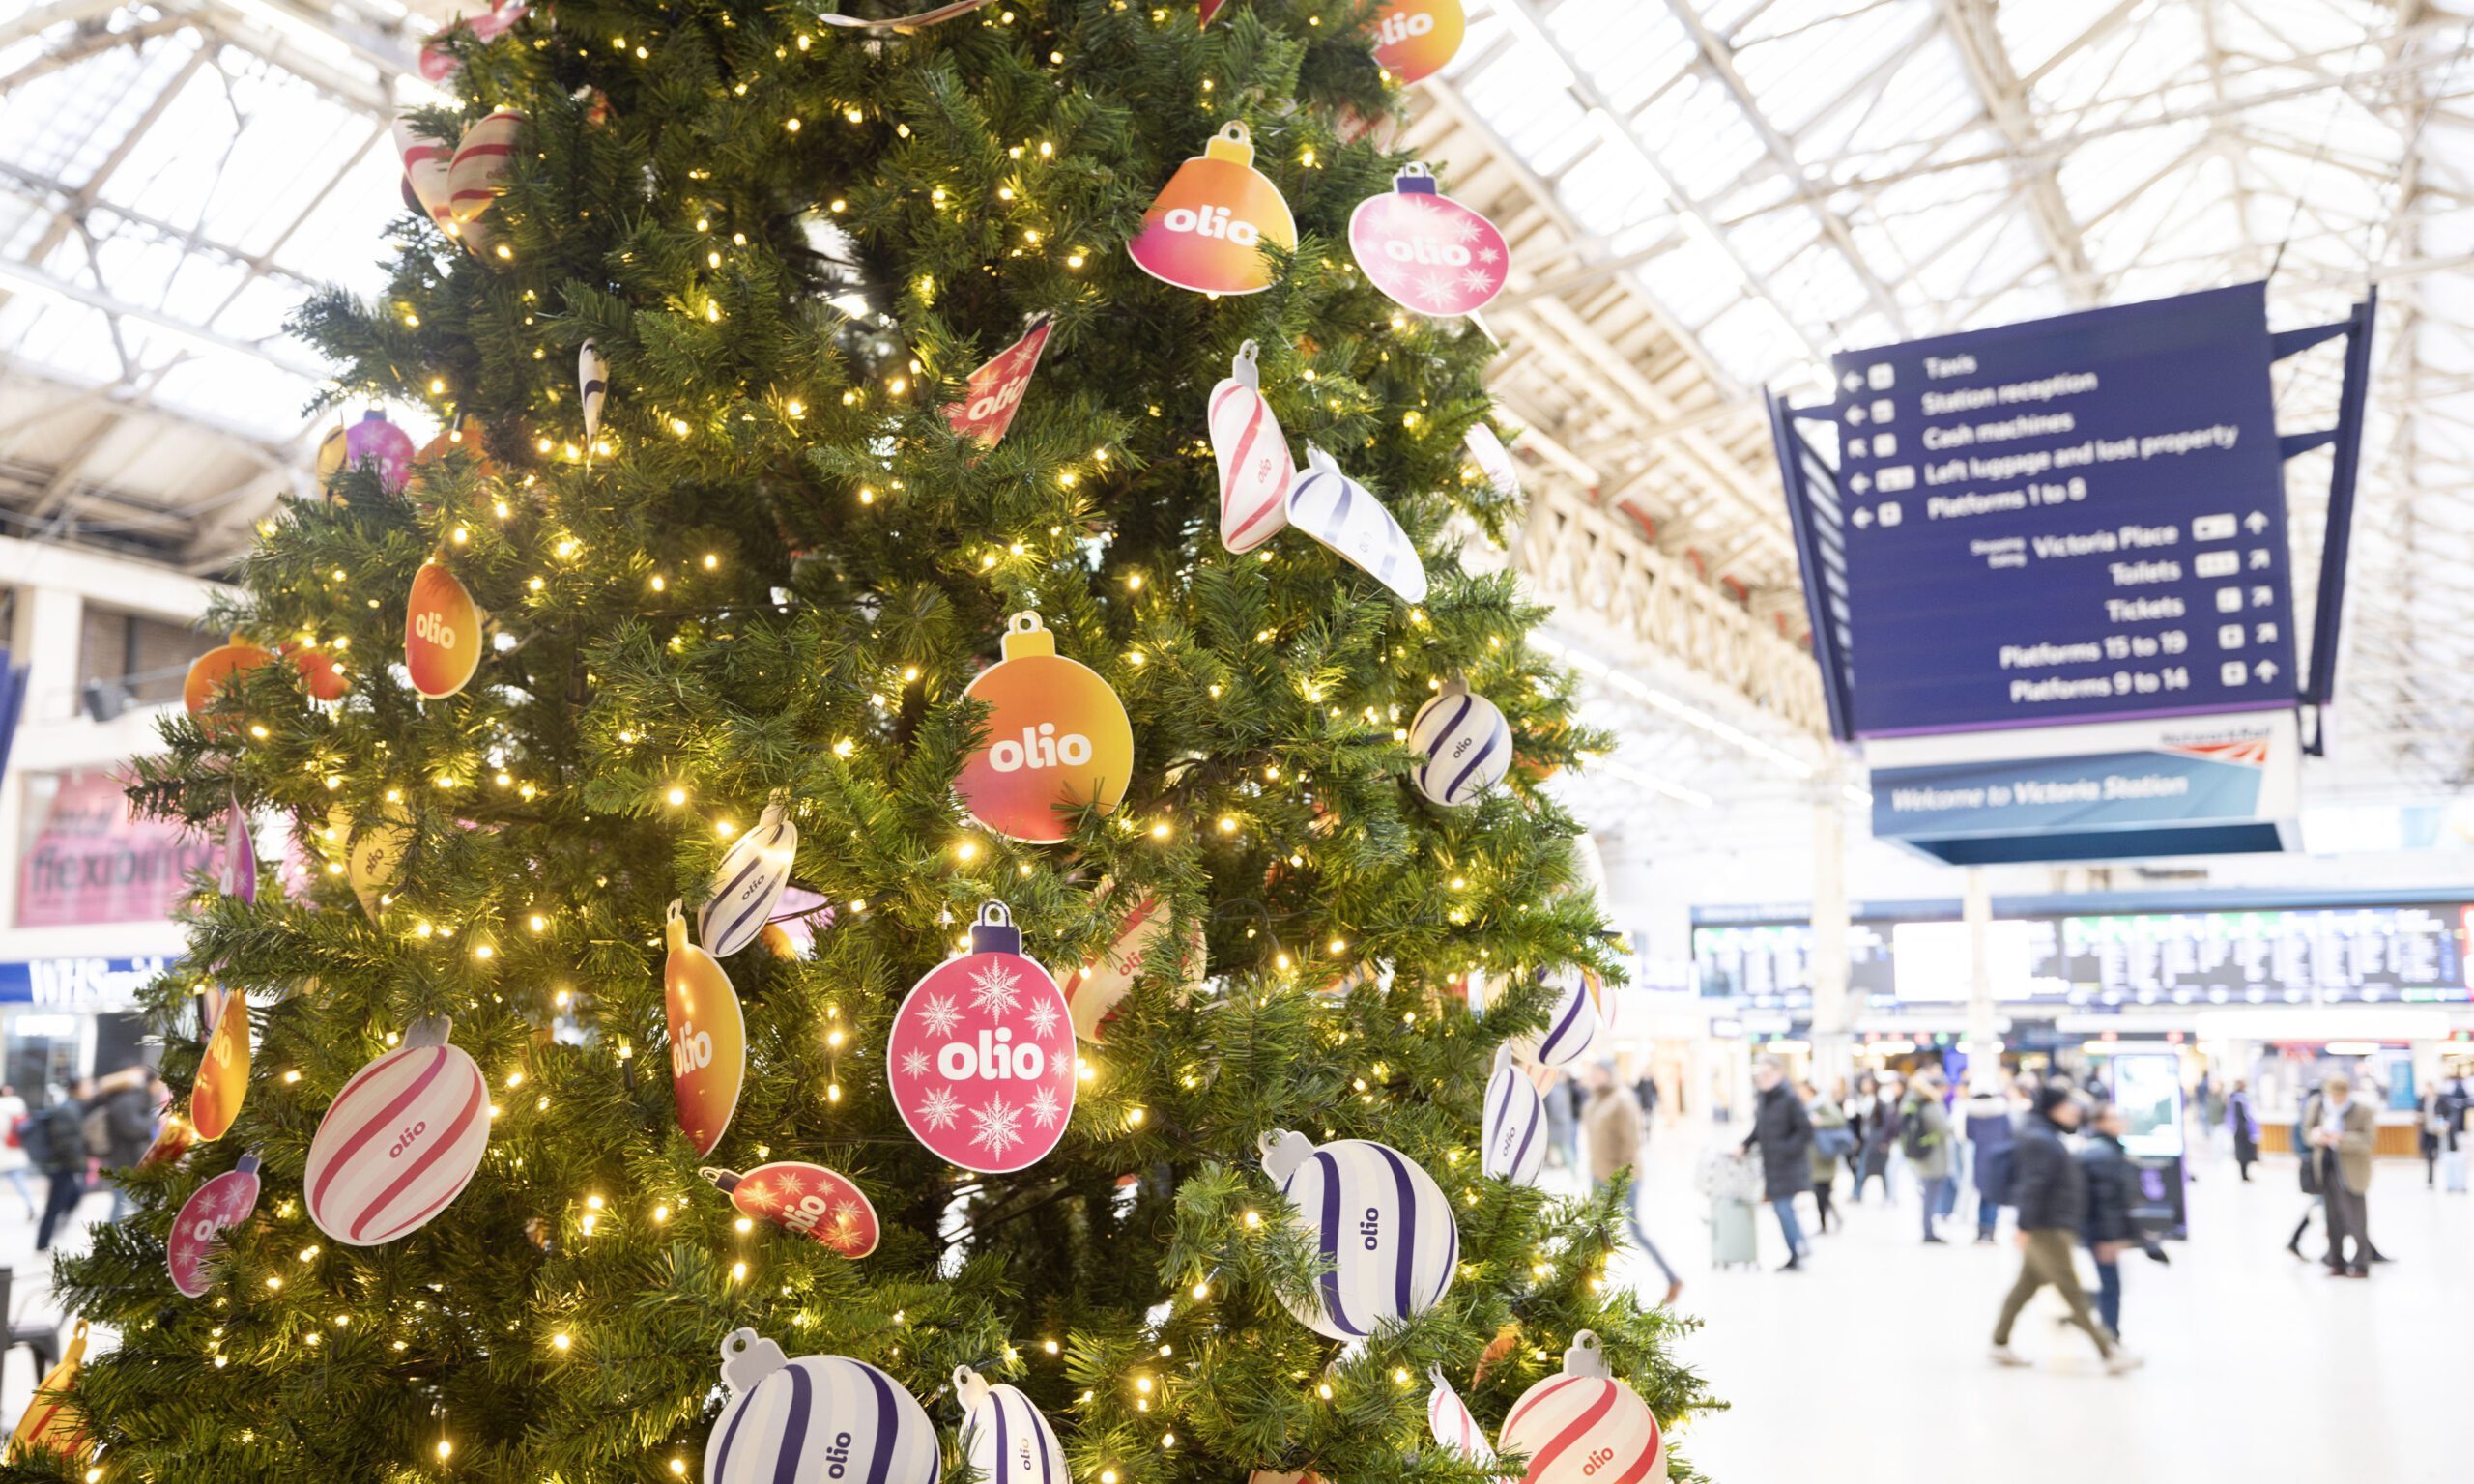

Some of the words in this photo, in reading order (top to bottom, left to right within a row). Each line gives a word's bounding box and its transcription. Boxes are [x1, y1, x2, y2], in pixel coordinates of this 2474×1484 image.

[1164, 204, 1259, 246] olio
[1385, 236, 1471, 267] olio
[1923, 354, 1977, 379] Taxis
[967, 376, 1028, 421] olio
[1922, 388, 1997, 415] Station
[1998, 372, 2098, 402] reception
[1923, 424, 1974, 450] Cash
[1976, 413, 2075, 443] machines
[1925, 460, 1968, 485] Left
[1969, 451, 2051, 480] luggage
[2054, 441, 2094, 468] and
[2095, 437, 2138, 462] lost
[2141, 424, 2238, 459] property
[1927, 491, 2027, 520] Platforms
[2028, 483, 2040, 506] 1
[2042, 483, 2067, 504] to
[2032, 530, 2117, 558] Victoria
[2119, 525, 2179, 549] Place
[2109, 560, 2182, 585] Toilets
[2105, 597, 2185, 622] Tickets
[416, 612, 455, 649] olio
[1999, 642, 2102, 670] Platforms
[2104, 635, 2130, 660] 15
[2132, 636, 2158, 657] to
[2160, 630, 2187, 655] 19
[2010, 676, 2113, 703] Platforms
[2114, 671, 2132, 695] 9
[2134, 671, 2160, 694] to
[2162, 667, 2189, 691] 14
[989, 722, 1093, 773] olio
[1453, 737, 1473, 759] olio
[1891, 786, 1985, 813] Welcome
[1987, 785, 2012, 808] to
[2014, 778, 2100, 805] Victoria
[2103, 773, 2189, 800] Station
[366, 848, 385, 875] olio
[741, 873, 765, 901] olio
[674, 1020, 712, 1079] olio
[937, 1027, 1044, 1080] olio
[389, 1121, 426, 1158] olio
[1502, 1127, 1516, 1157] olio
[1359, 1207, 1379, 1251] olio
[825, 1432, 852, 1480] olio
[1020, 1437, 1031, 1470] olio
[1582, 1447, 1615, 1477] olio
